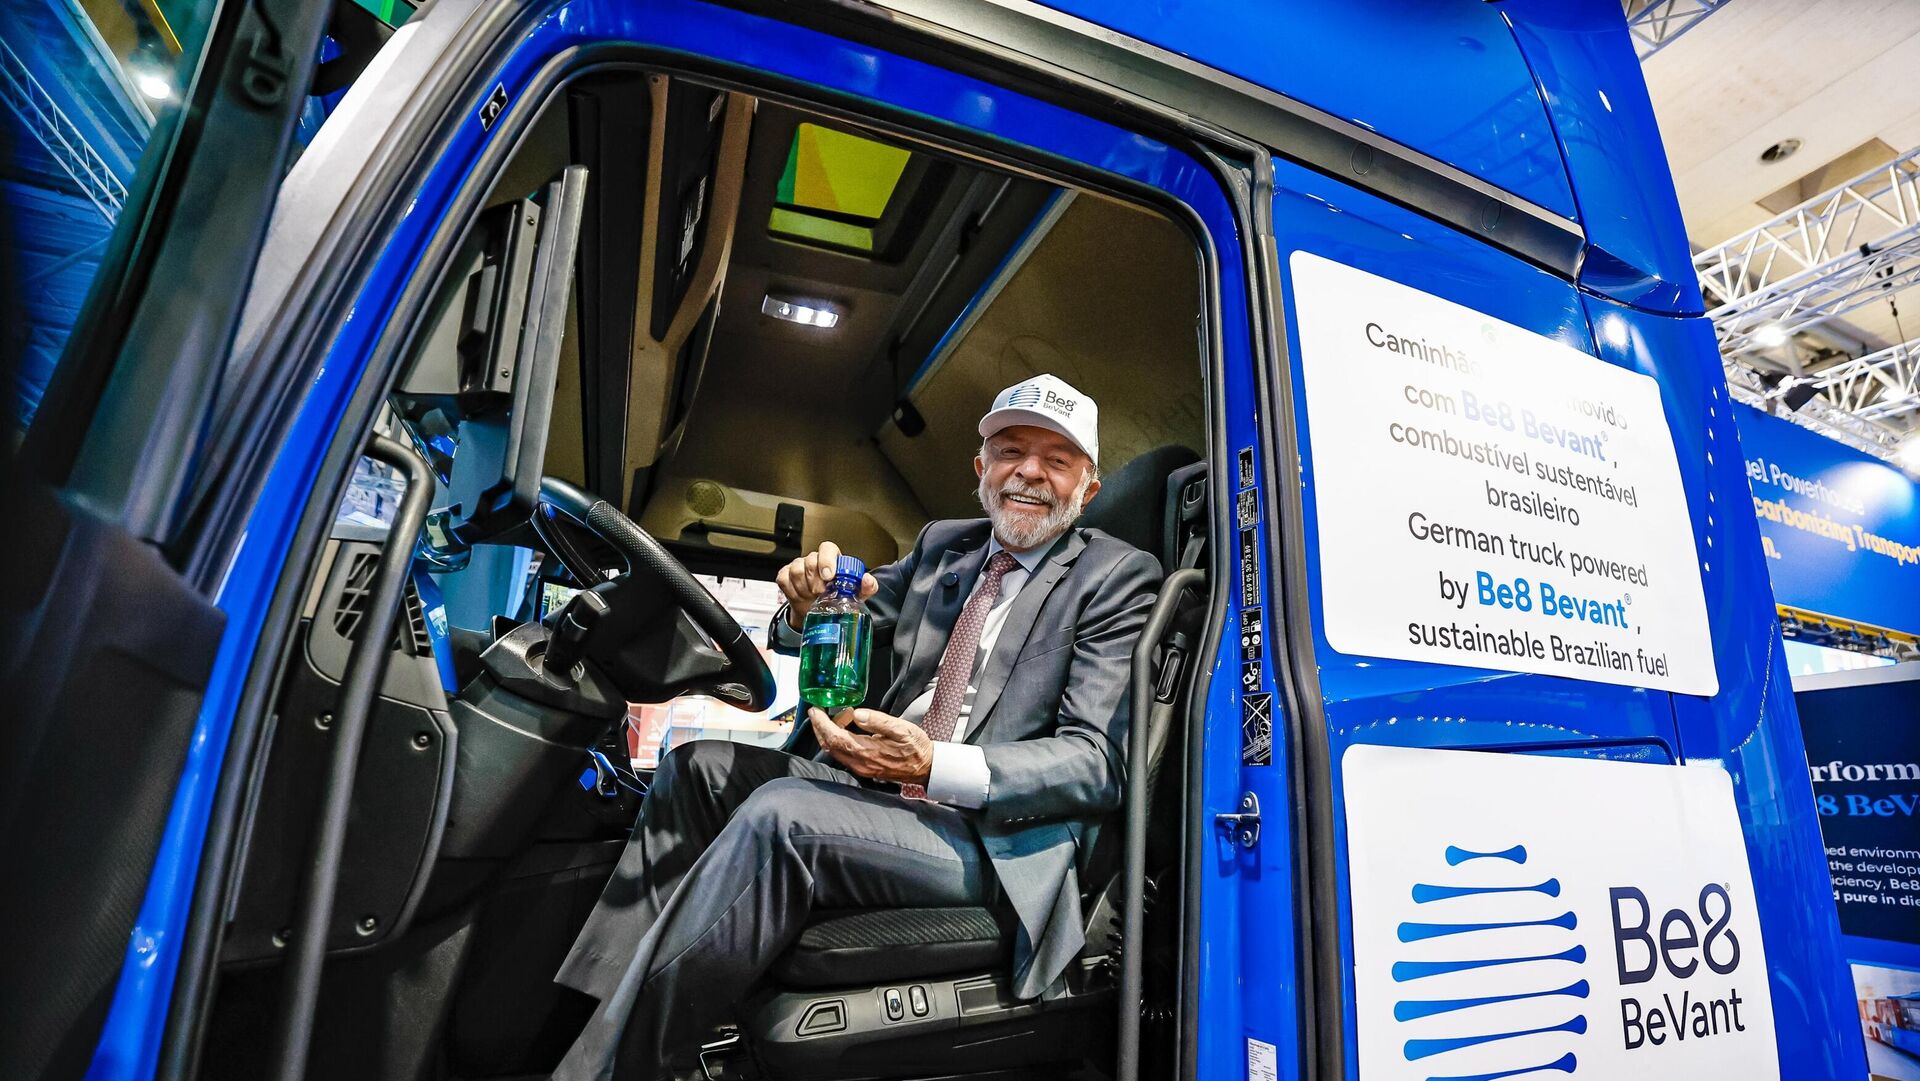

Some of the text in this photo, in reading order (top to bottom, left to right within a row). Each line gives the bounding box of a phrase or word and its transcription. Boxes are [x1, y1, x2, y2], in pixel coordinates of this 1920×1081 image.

[1365, 322, 1482, 377] Caminhão
[1042, 402, 1071, 419] BeVant
[1404, 383, 1456, 416] com
[1462, 389, 1516, 432] Be8
[1389, 420, 1638, 509] combustível sustentável
[1485, 480, 1581, 527] brasileiro
[1753, 496, 1856, 552] carbonizing
[1408, 511, 1649, 588] German truck powered
[1439, 570, 1469, 610] by
[1476, 570, 1533, 612] Be8
[1408, 620, 1669, 679] sustainable Brazilian fuel
[1809, 760, 1920, 782] rform
[1829, 860, 1920, 877] the develop
[1889, 878, 1920, 891] Be8
[1843, 892, 1878, 904] pure
[1880, 892, 1896, 905] in
[1620, 988, 1746, 1050] BeVant
